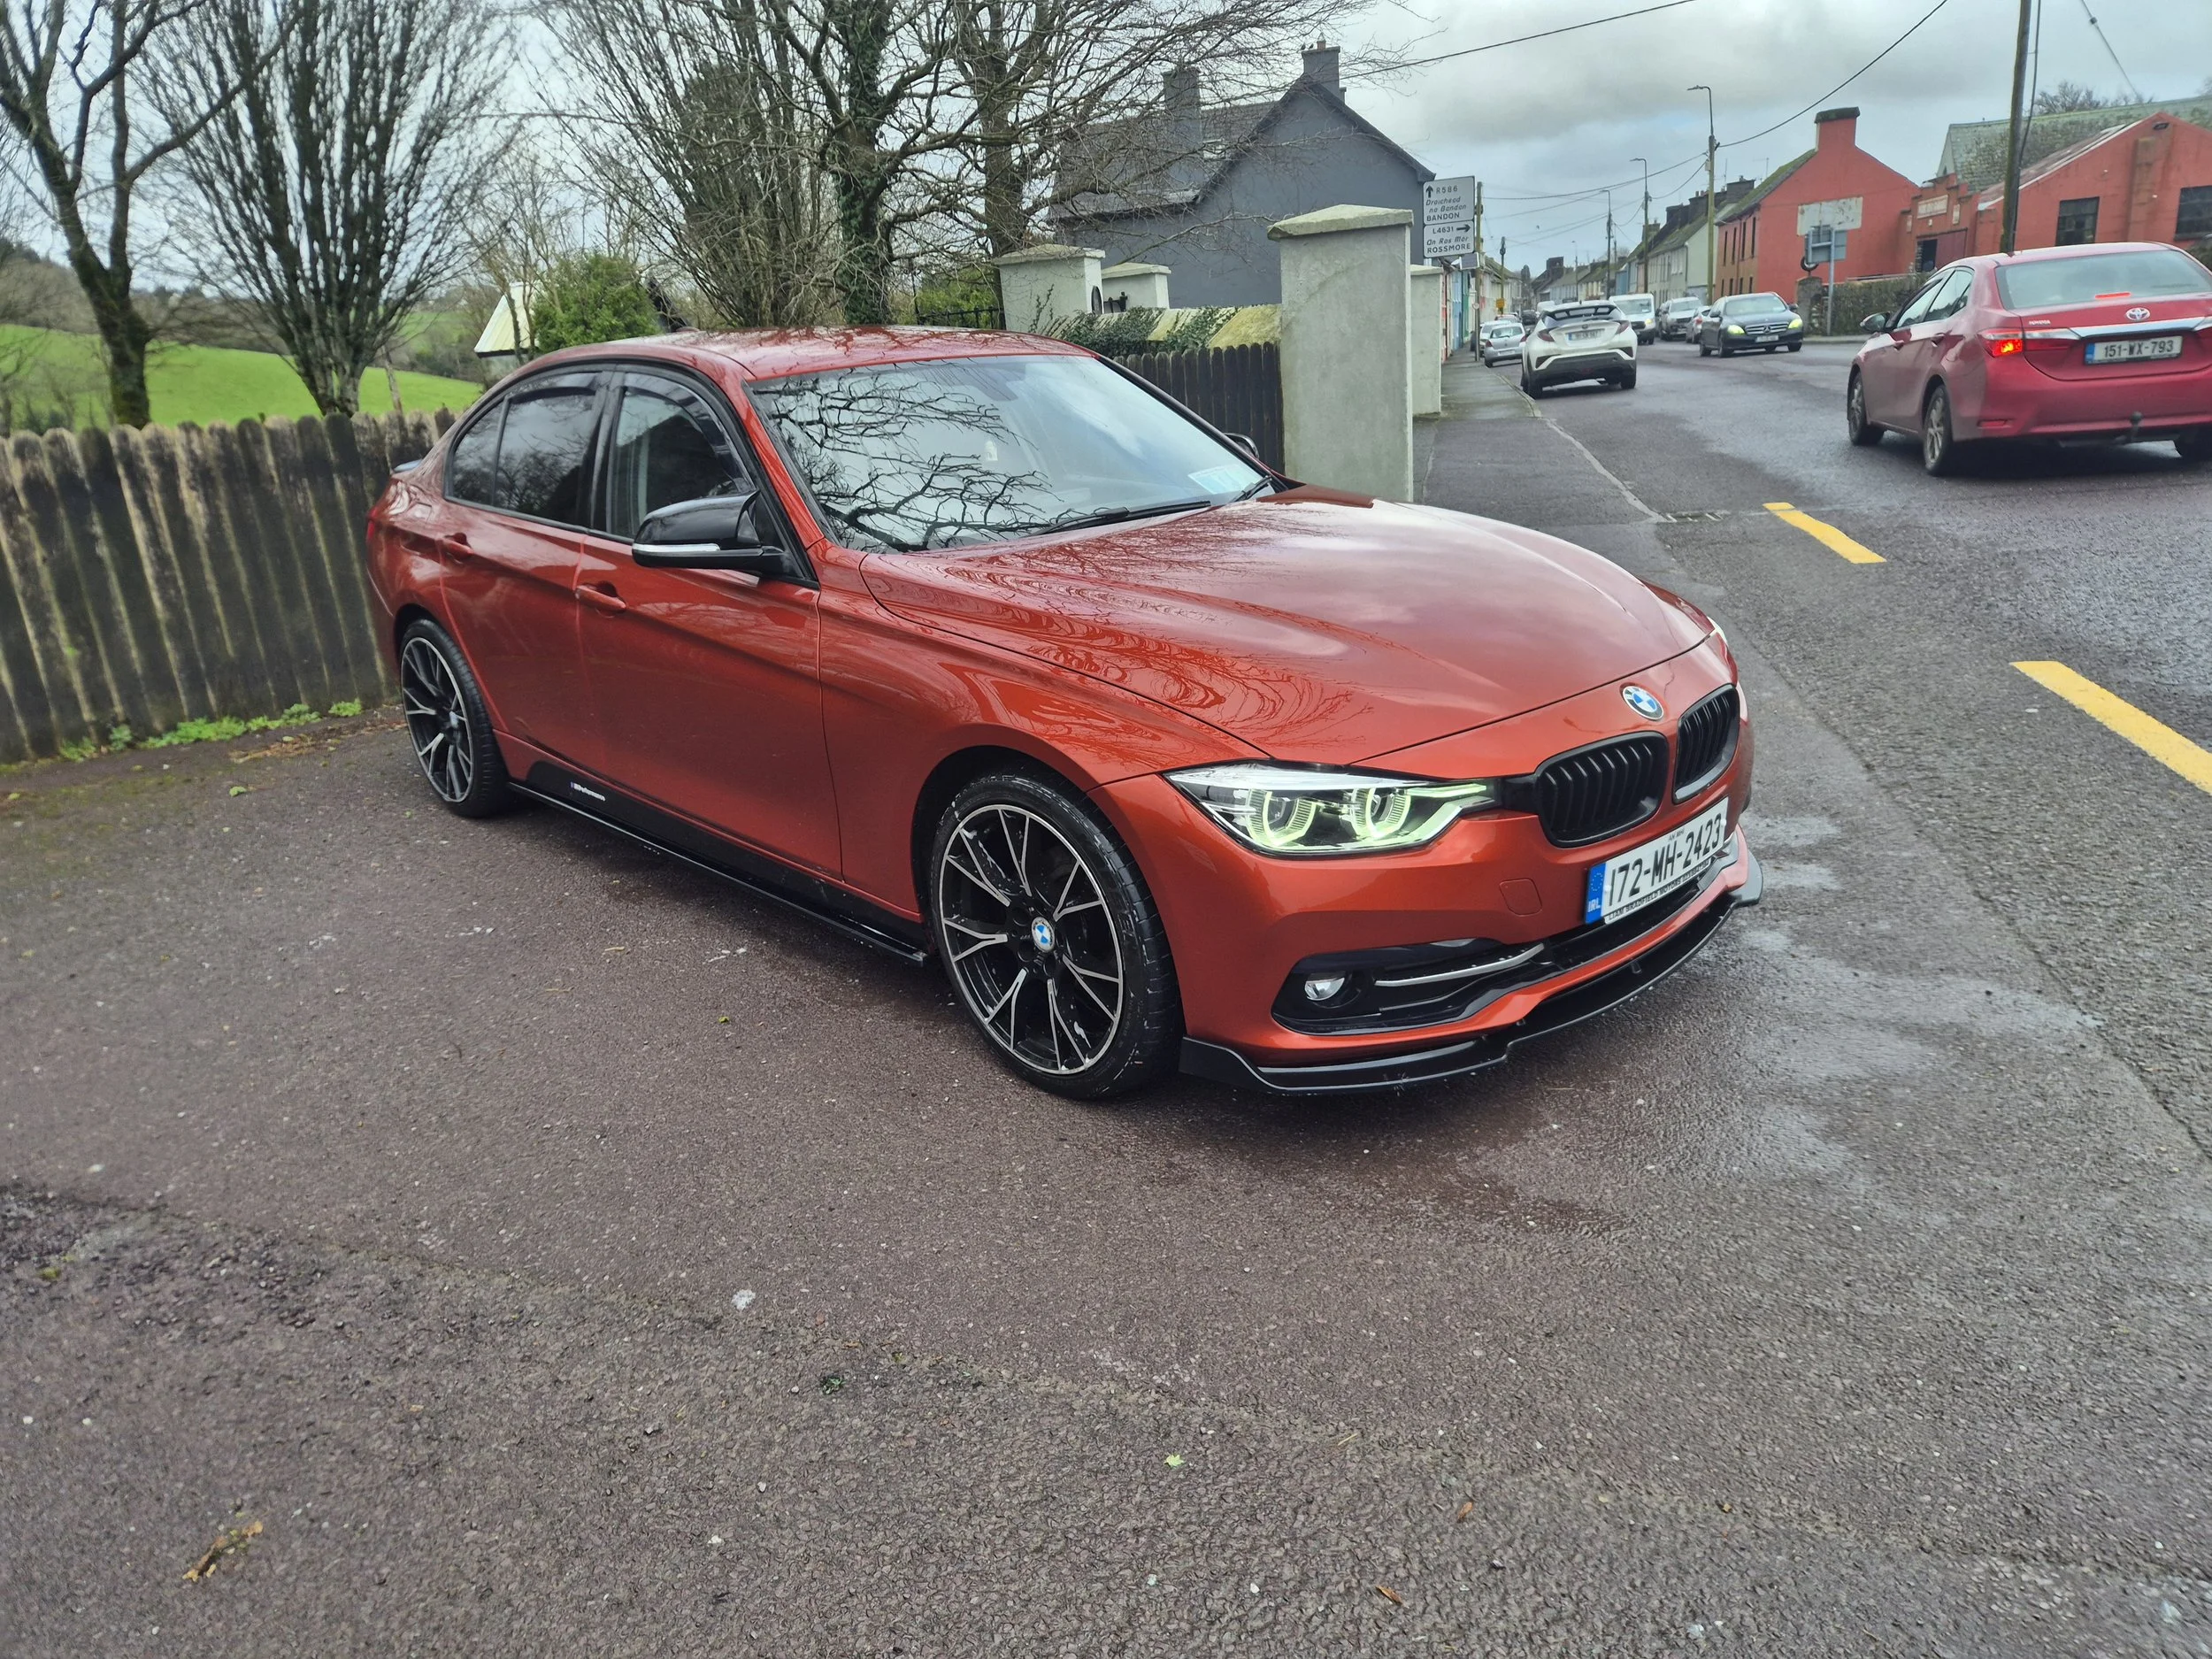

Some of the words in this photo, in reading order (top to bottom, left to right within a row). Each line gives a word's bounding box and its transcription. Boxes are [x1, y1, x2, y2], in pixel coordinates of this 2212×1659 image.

[1436, 185, 1458, 195] R586
[1426, 212, 1460, 222] BANDON
[1432, 226, 1454, 234] L4631
[1426, 242, 1471, 254] ROSSMORE
[2104, 340, 2174, 358] 151-WX-793
[1609, 813, 1722, 907] 172-MH-2423
[1587, 897, 1601, 913] IRL
[1608, 908, 1625, 921] LIAM
[1625, 890, 1658, 912] BRADFIELD
[1659, 877, 1682, 895] MOTORS
